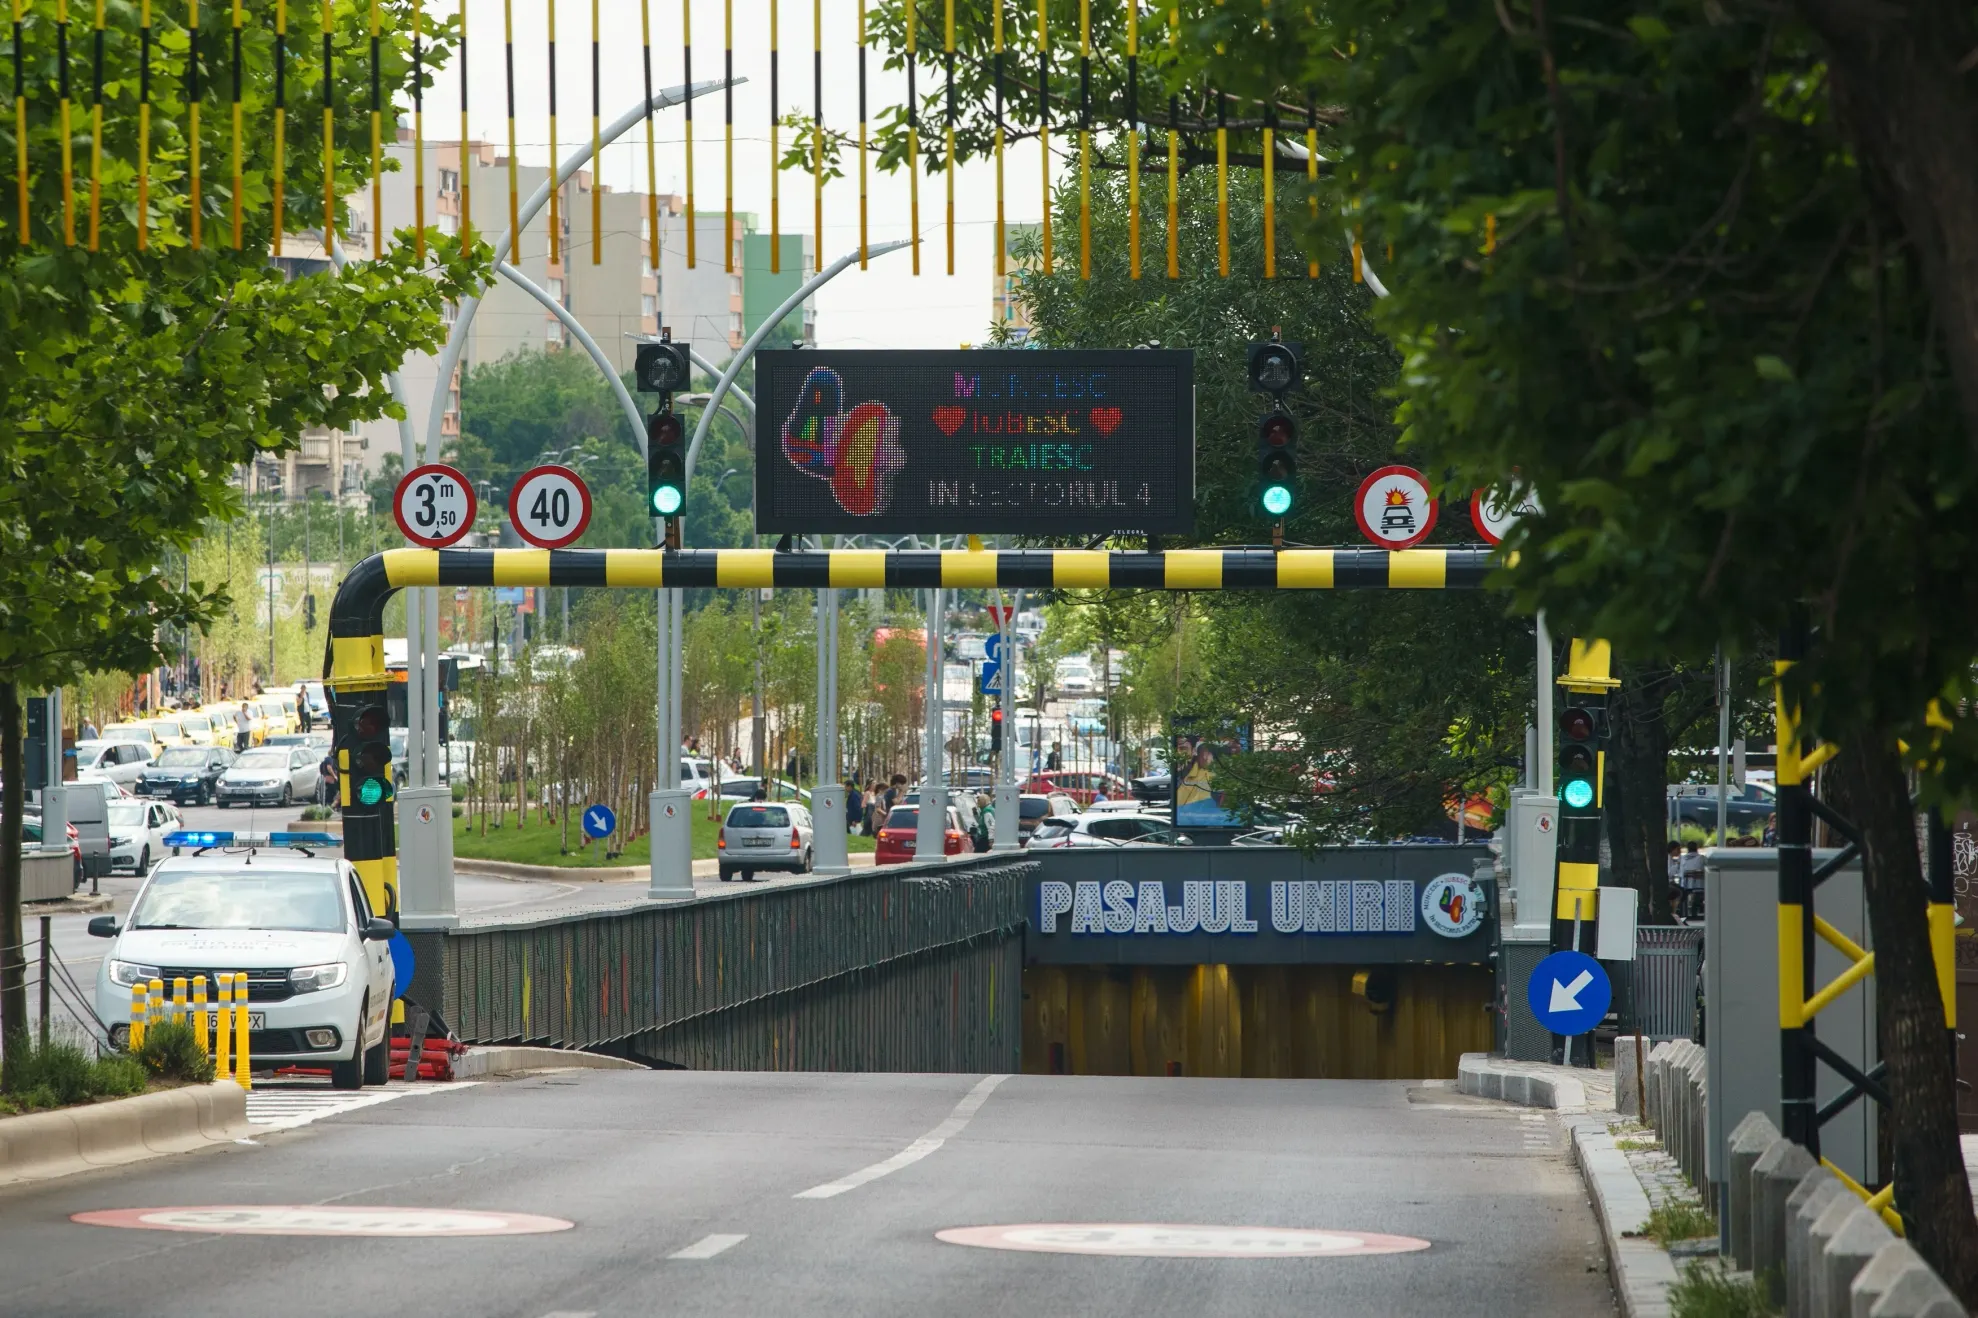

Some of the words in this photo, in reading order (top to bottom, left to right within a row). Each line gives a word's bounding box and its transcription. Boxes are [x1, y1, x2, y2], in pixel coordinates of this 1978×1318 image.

[530, 488, 570, 528] 40
[929, 480, 959, 506] IN
[1136, 482, 1151, 506] 4
[1040, 880, 1259, 933] PASAJUL
[1271, 879, 1416, 932] UNIRII
